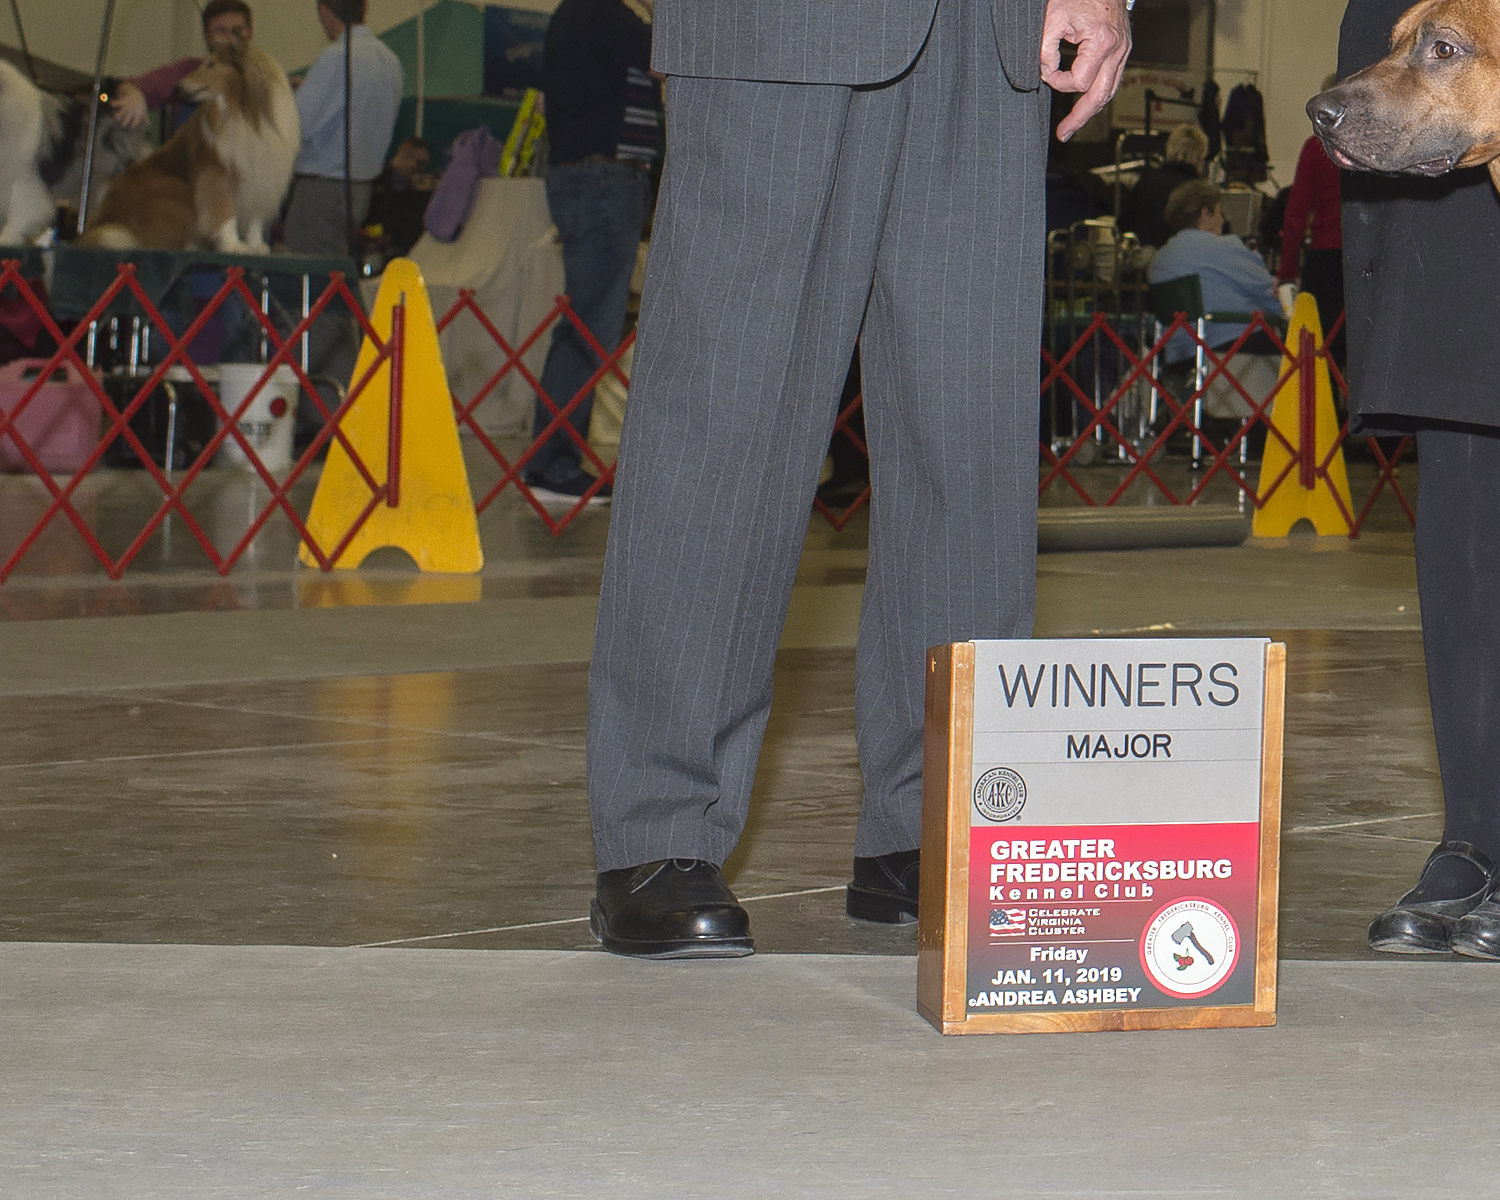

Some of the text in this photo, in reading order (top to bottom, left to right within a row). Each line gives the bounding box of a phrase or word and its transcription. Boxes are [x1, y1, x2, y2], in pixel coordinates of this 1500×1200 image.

[998, 662, 1240, 708] WINNERS
[1066, 733, 1172, 759] MAJOR
[990, 839, 1115, 860] GREATER
[990, 859, 1232, 883] FREDERICKSBURG
[989, 883, 1153, 900] Kennel Club
[1030, 946, 1088, 964] Friday
[991, 966, 1123, 986] JAN. 11, 2019
[1062, 987, 1142, 1004] ASHBEY
